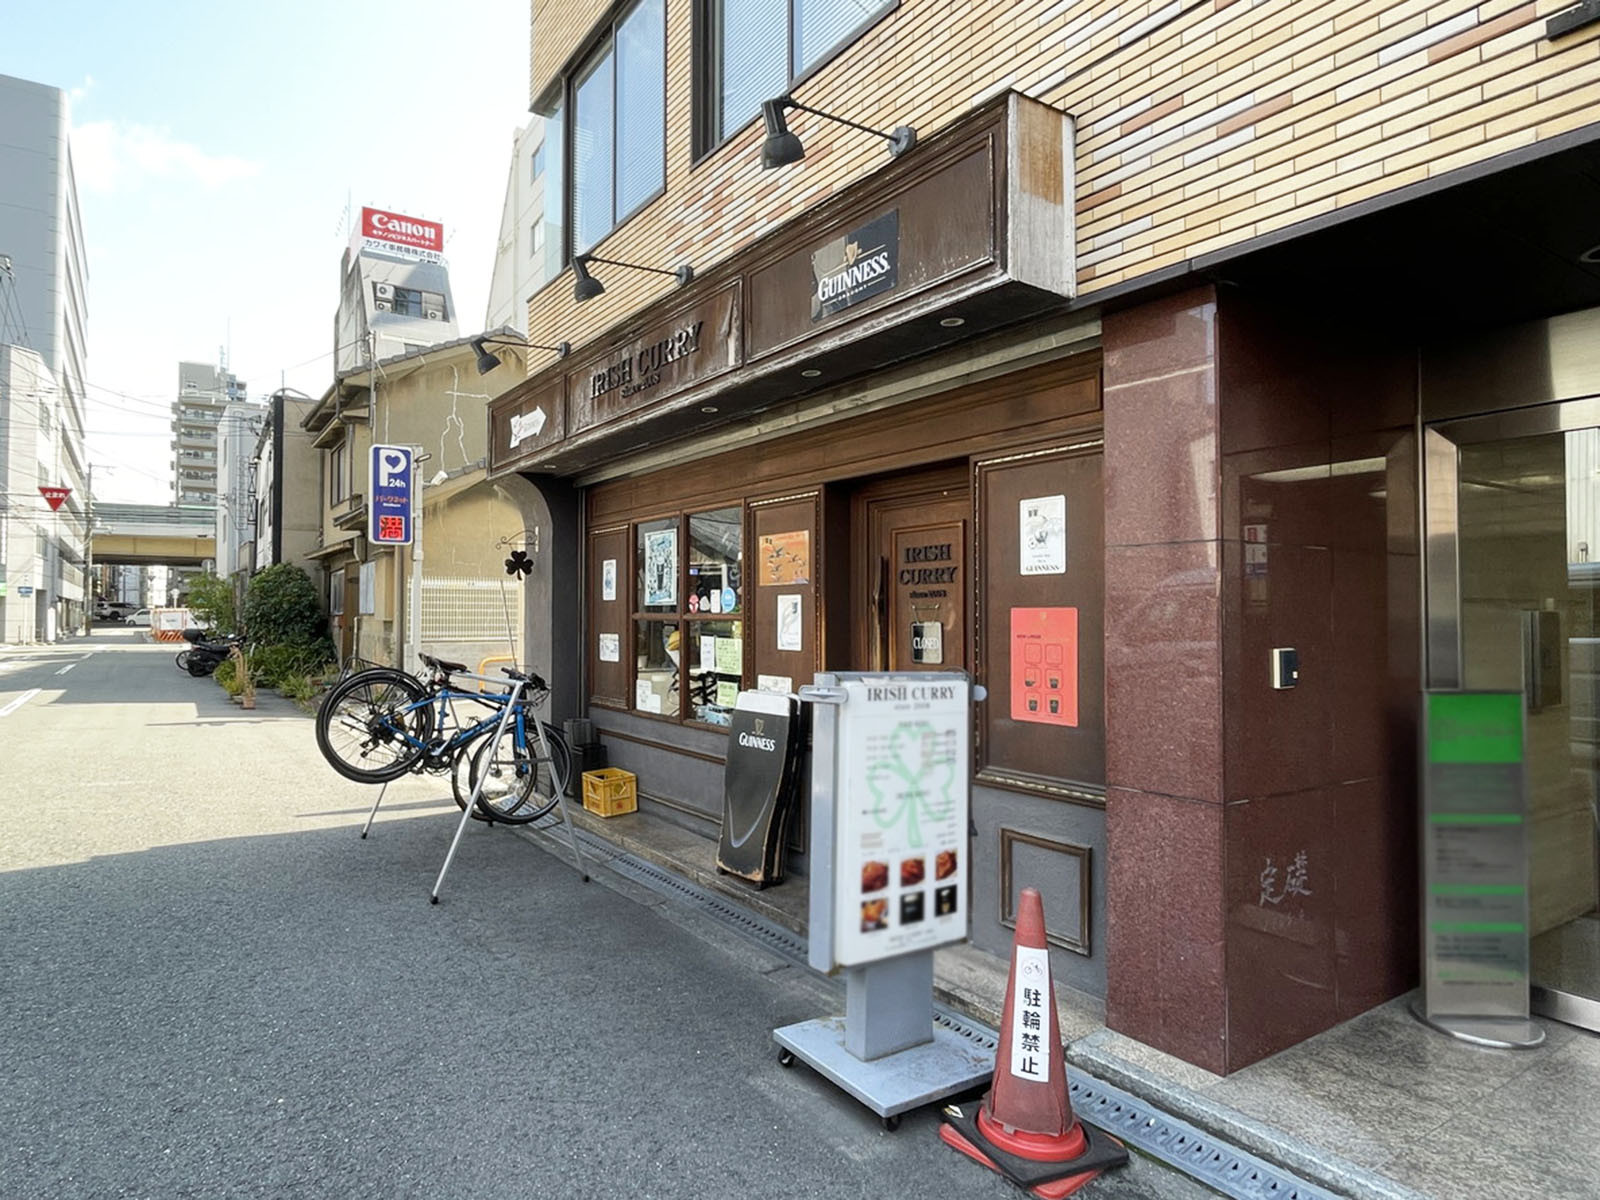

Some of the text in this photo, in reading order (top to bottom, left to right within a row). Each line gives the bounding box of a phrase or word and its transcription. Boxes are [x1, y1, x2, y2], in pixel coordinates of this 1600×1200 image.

[372, 213, 436, 239] Canon
[818, 251, 890, 302] GUINNESS
[588, 320, 703, 400] IRISH CURRY
[389, 478, 406, 488] 24h
[379, 516, 405, 540] 満
[904, 543, 952, 563] IRISH
[899, 566, 958, 585] CURRY
[867, 685, 955, 701] IRISH CURRY
[738, 731, 776, 752] GUINNESS
[1020, 987, 1042, 1076] 駐輪禁止
